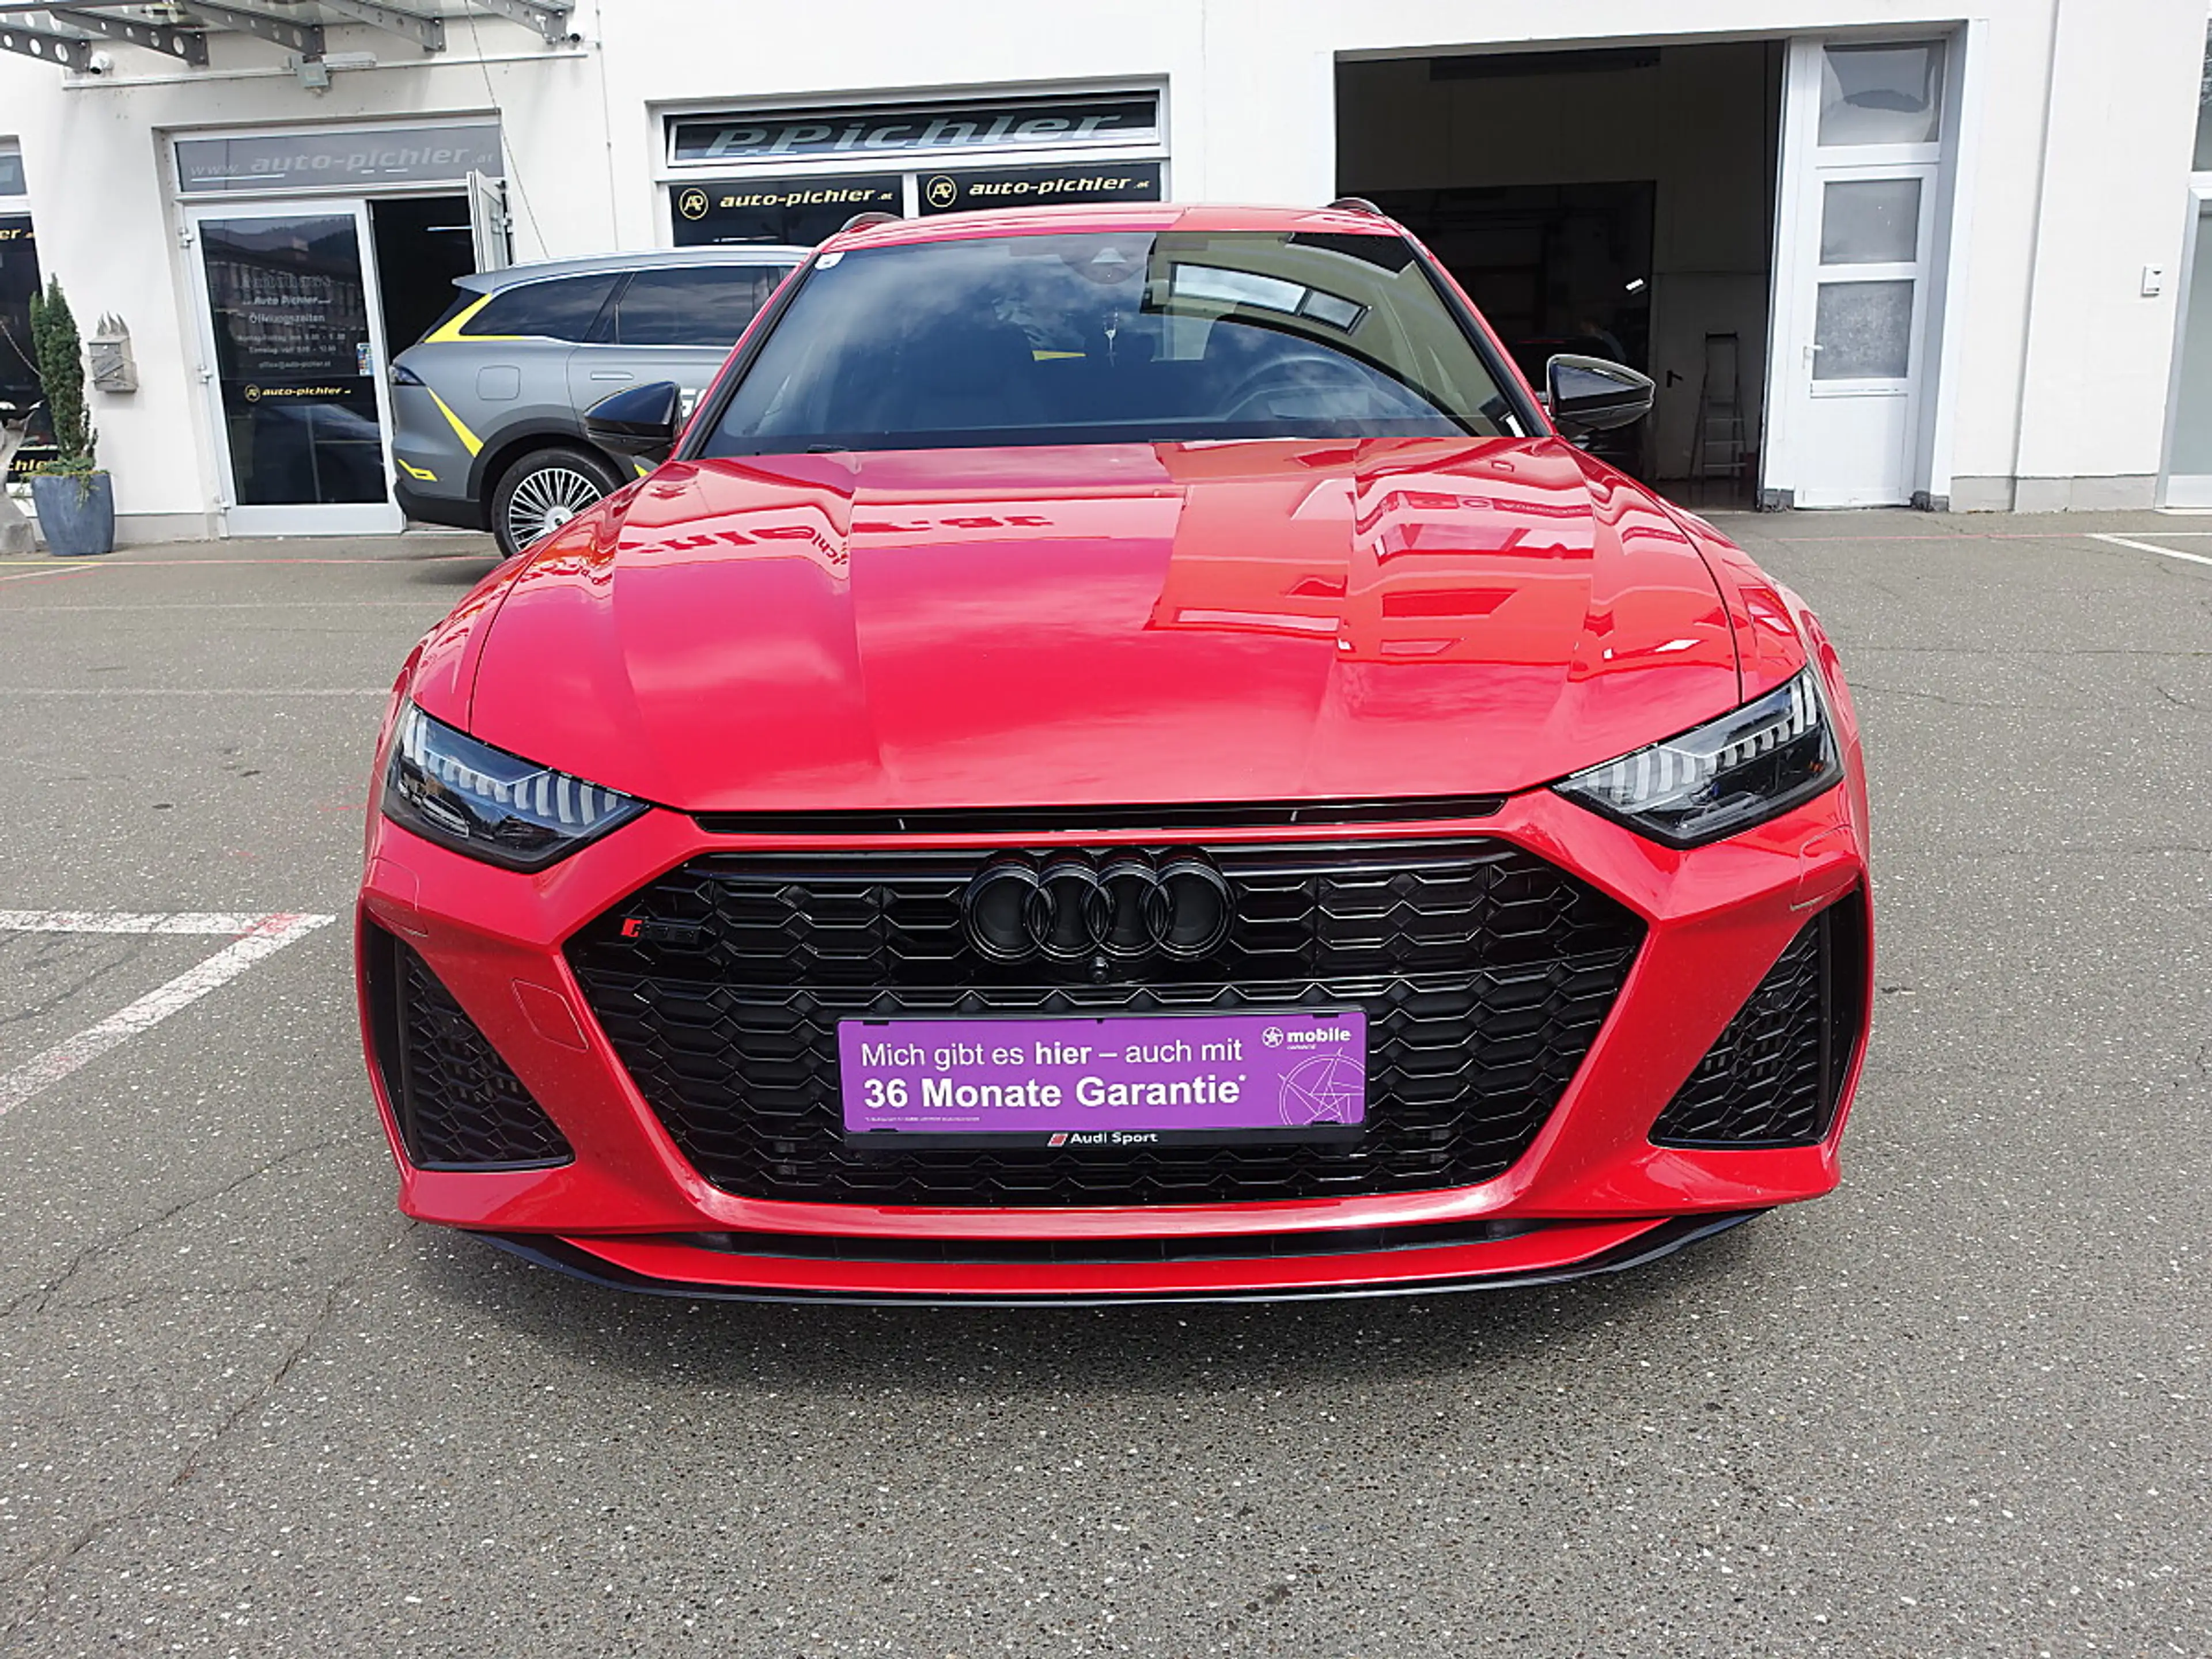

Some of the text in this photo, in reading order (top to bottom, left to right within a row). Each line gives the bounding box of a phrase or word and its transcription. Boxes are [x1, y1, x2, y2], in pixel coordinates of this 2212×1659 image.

[1286, 1027, 1351, 1043] mobile
[861, 1043, 925, 1066] Mich
[934, 1043, 985, 1071] gibt
[991, 1047, 1024, 1065] es
[1036, 1041, 1092, 1065] hier
[1125, 1039, 1192, 1063] auch
[1202, 1037, 1243, 1061] mit
[864, 1078, 908, 1108] 36
[922, 1077, 1062, 1107] Monate
[1070, 1132, 1158, 1145] Audi Sport
